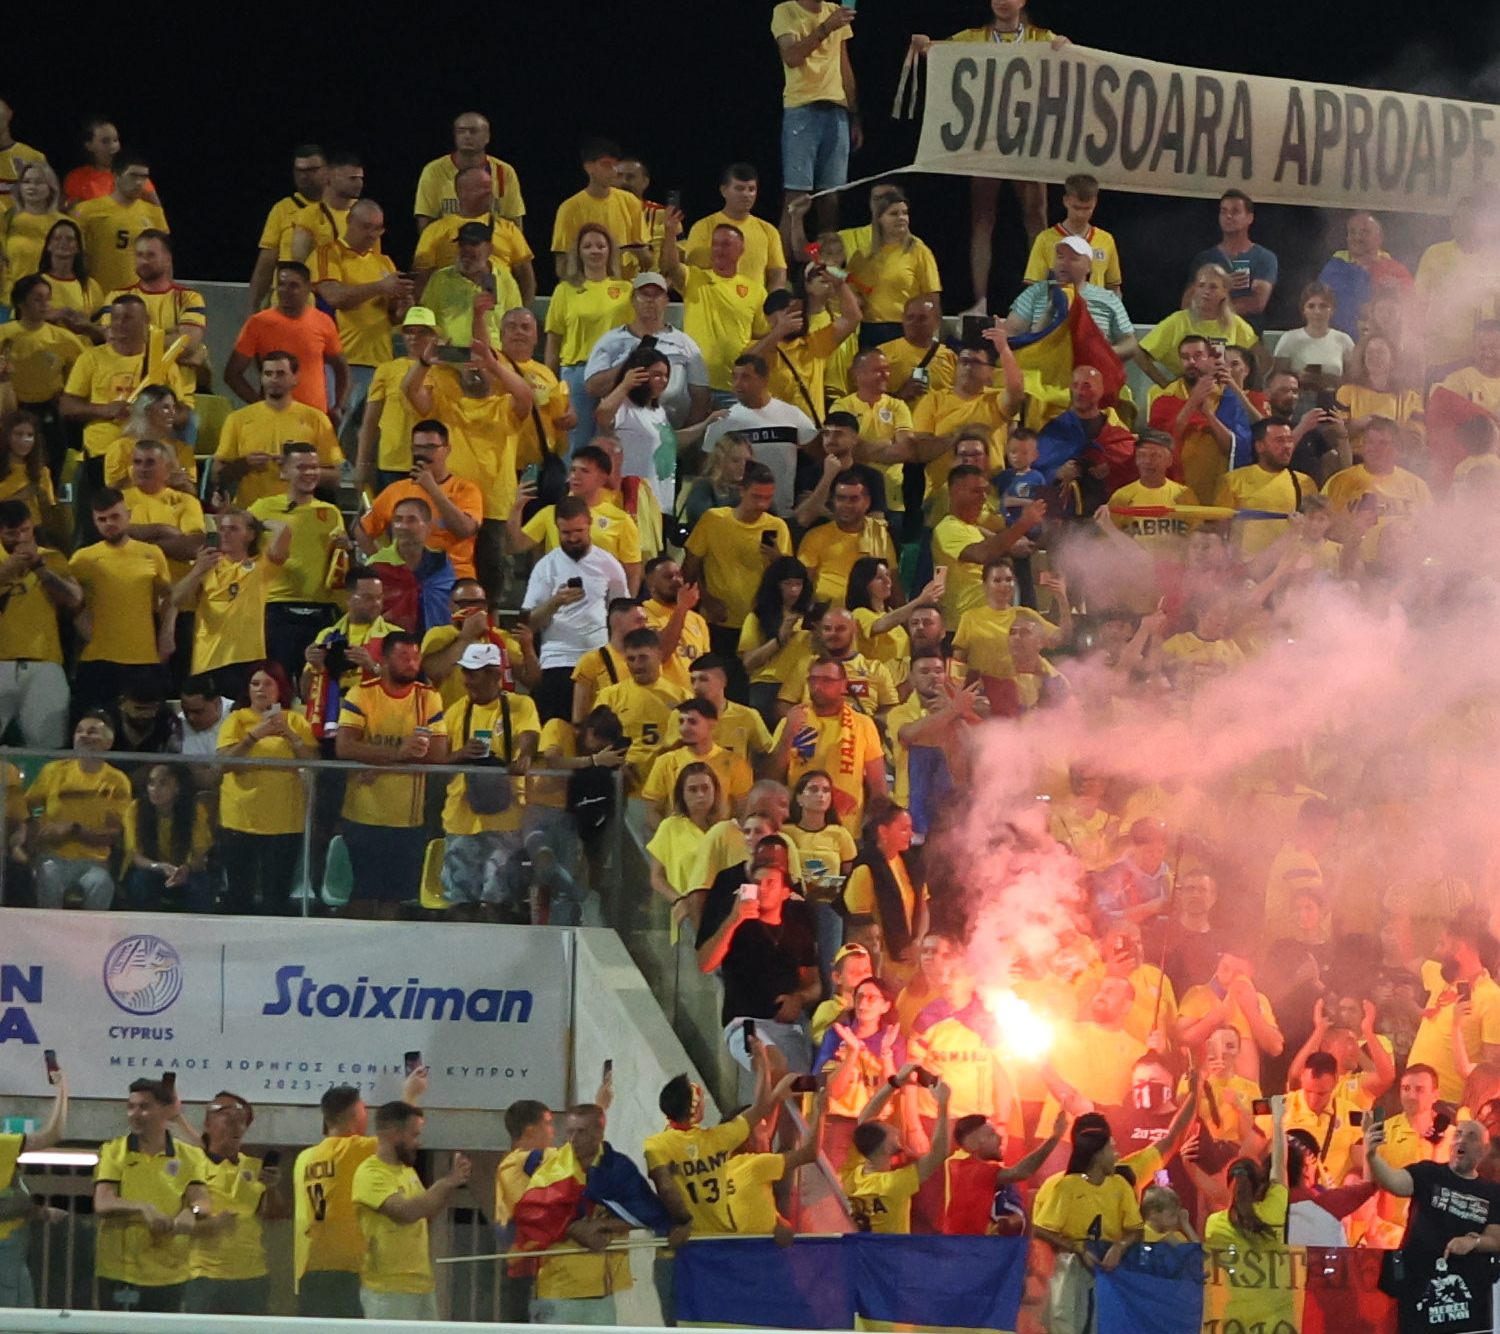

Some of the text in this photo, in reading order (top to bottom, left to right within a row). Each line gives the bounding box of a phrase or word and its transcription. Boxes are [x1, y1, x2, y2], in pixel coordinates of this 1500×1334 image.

[939, 56, 1254, 181] SIGHISOARA
[116, 230, 129, 249] 5
[642, 723, 659, 746] 5
[262, 965, 534, 1023] Stoiximan
[108, 1025, 174, 1041] CYPRUS
[110, 1055, 210, 1069] ΜΕΓΑΛΟΣ
[225, 1059, 323, 1073] ΧΟΡΗΓΟΣ
[446, 1066, 530, 1079] ΚΥΠΡΟΥ
[686, 1178, 720, 1205] 13
[1428, 1302, 1469, 1316] MEREU
[1449, 1310, 1470, 1322] NOI
